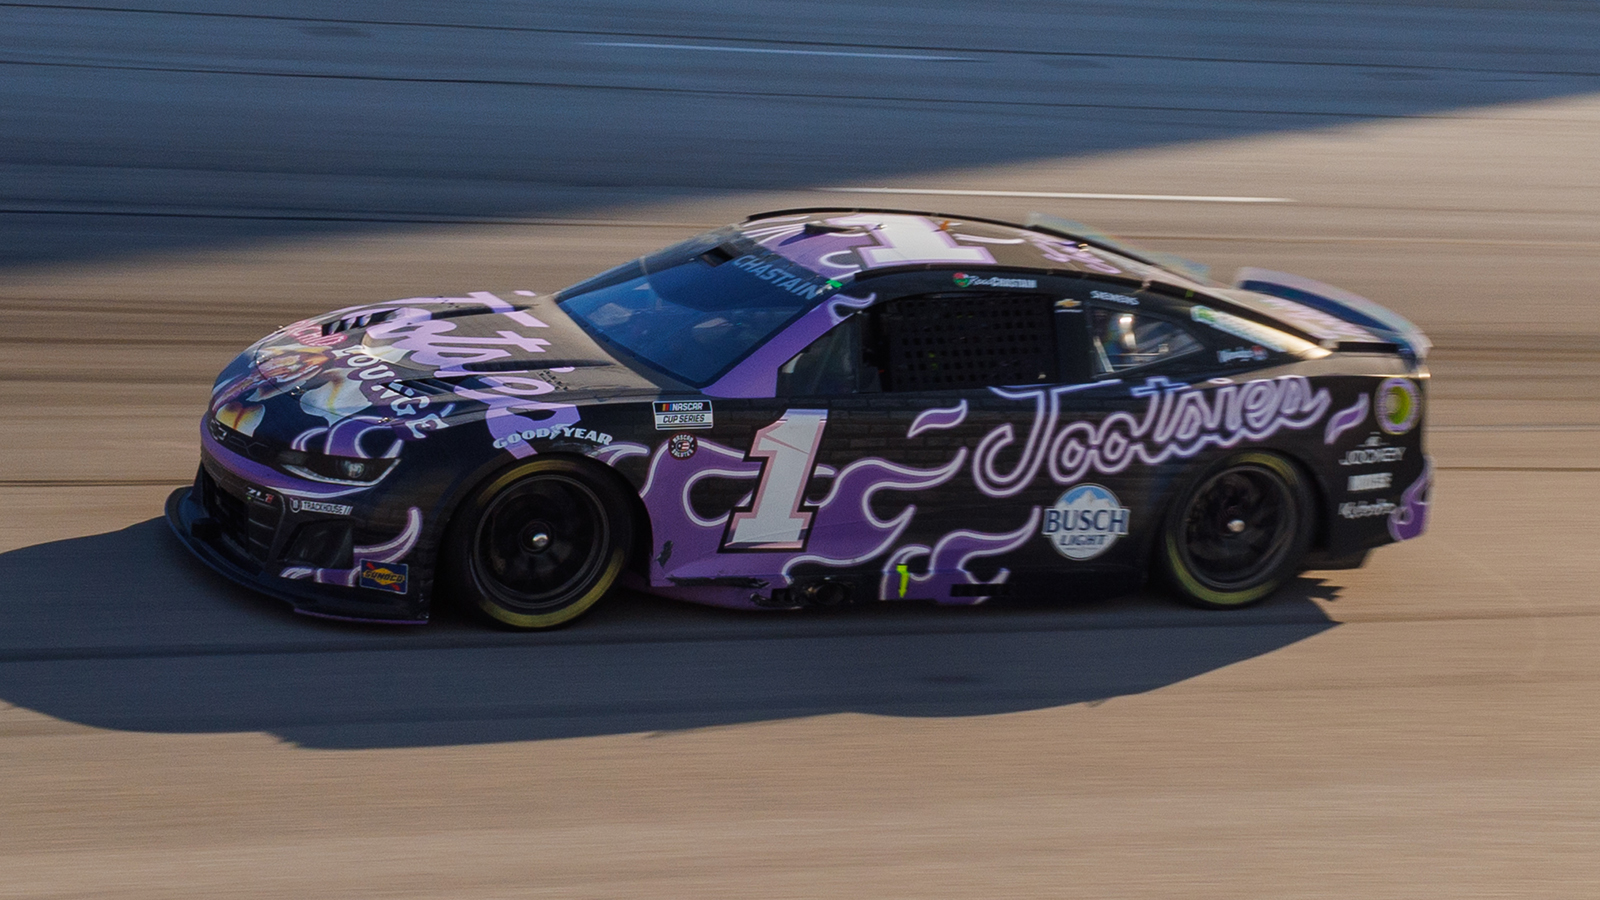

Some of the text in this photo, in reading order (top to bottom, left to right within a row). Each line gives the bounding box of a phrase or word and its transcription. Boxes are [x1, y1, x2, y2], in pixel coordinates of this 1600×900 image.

[828, 213, 998, 268] 1
[733, 254, 821, 300] CHASTAIN
[672, 403, 704, 411] NASCAR
[663, 414, 705, 424] CUP SERIES
[493, 424, 613, 449] GOODYEAR
[718, 409, 828, 552] 1
[303, 501, 345, 514] TRACKHOUSE
[1046, 509, 1129, 533] BUSCH
[1060, 535, 1107, 546] LIGHT
[363, 569, 406, 584] SUNOCO
